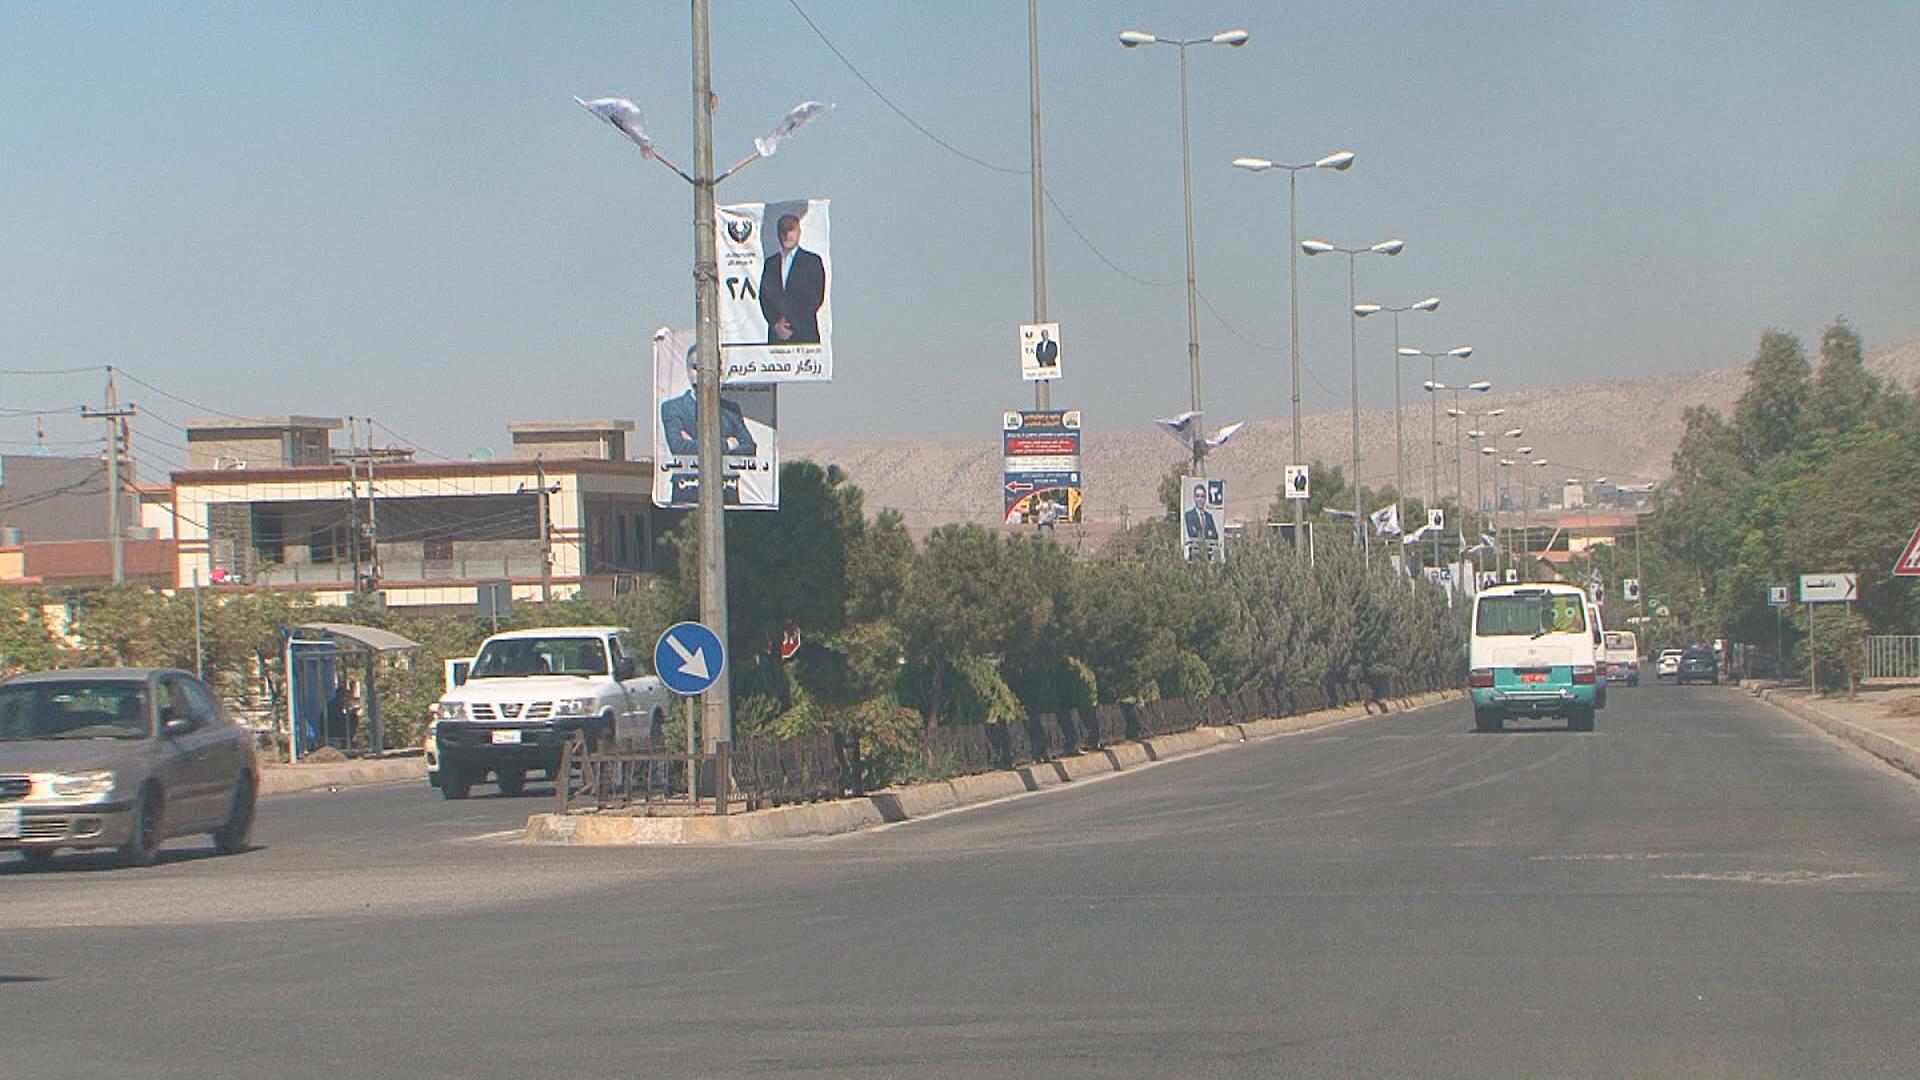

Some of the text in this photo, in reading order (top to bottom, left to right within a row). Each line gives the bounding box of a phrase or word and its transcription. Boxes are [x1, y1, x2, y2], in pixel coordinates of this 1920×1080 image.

[726, 277, 757, 300] ٢٨
[760, 362, 791, 373] محمد
[795, 358, 822, 375] رزگار
